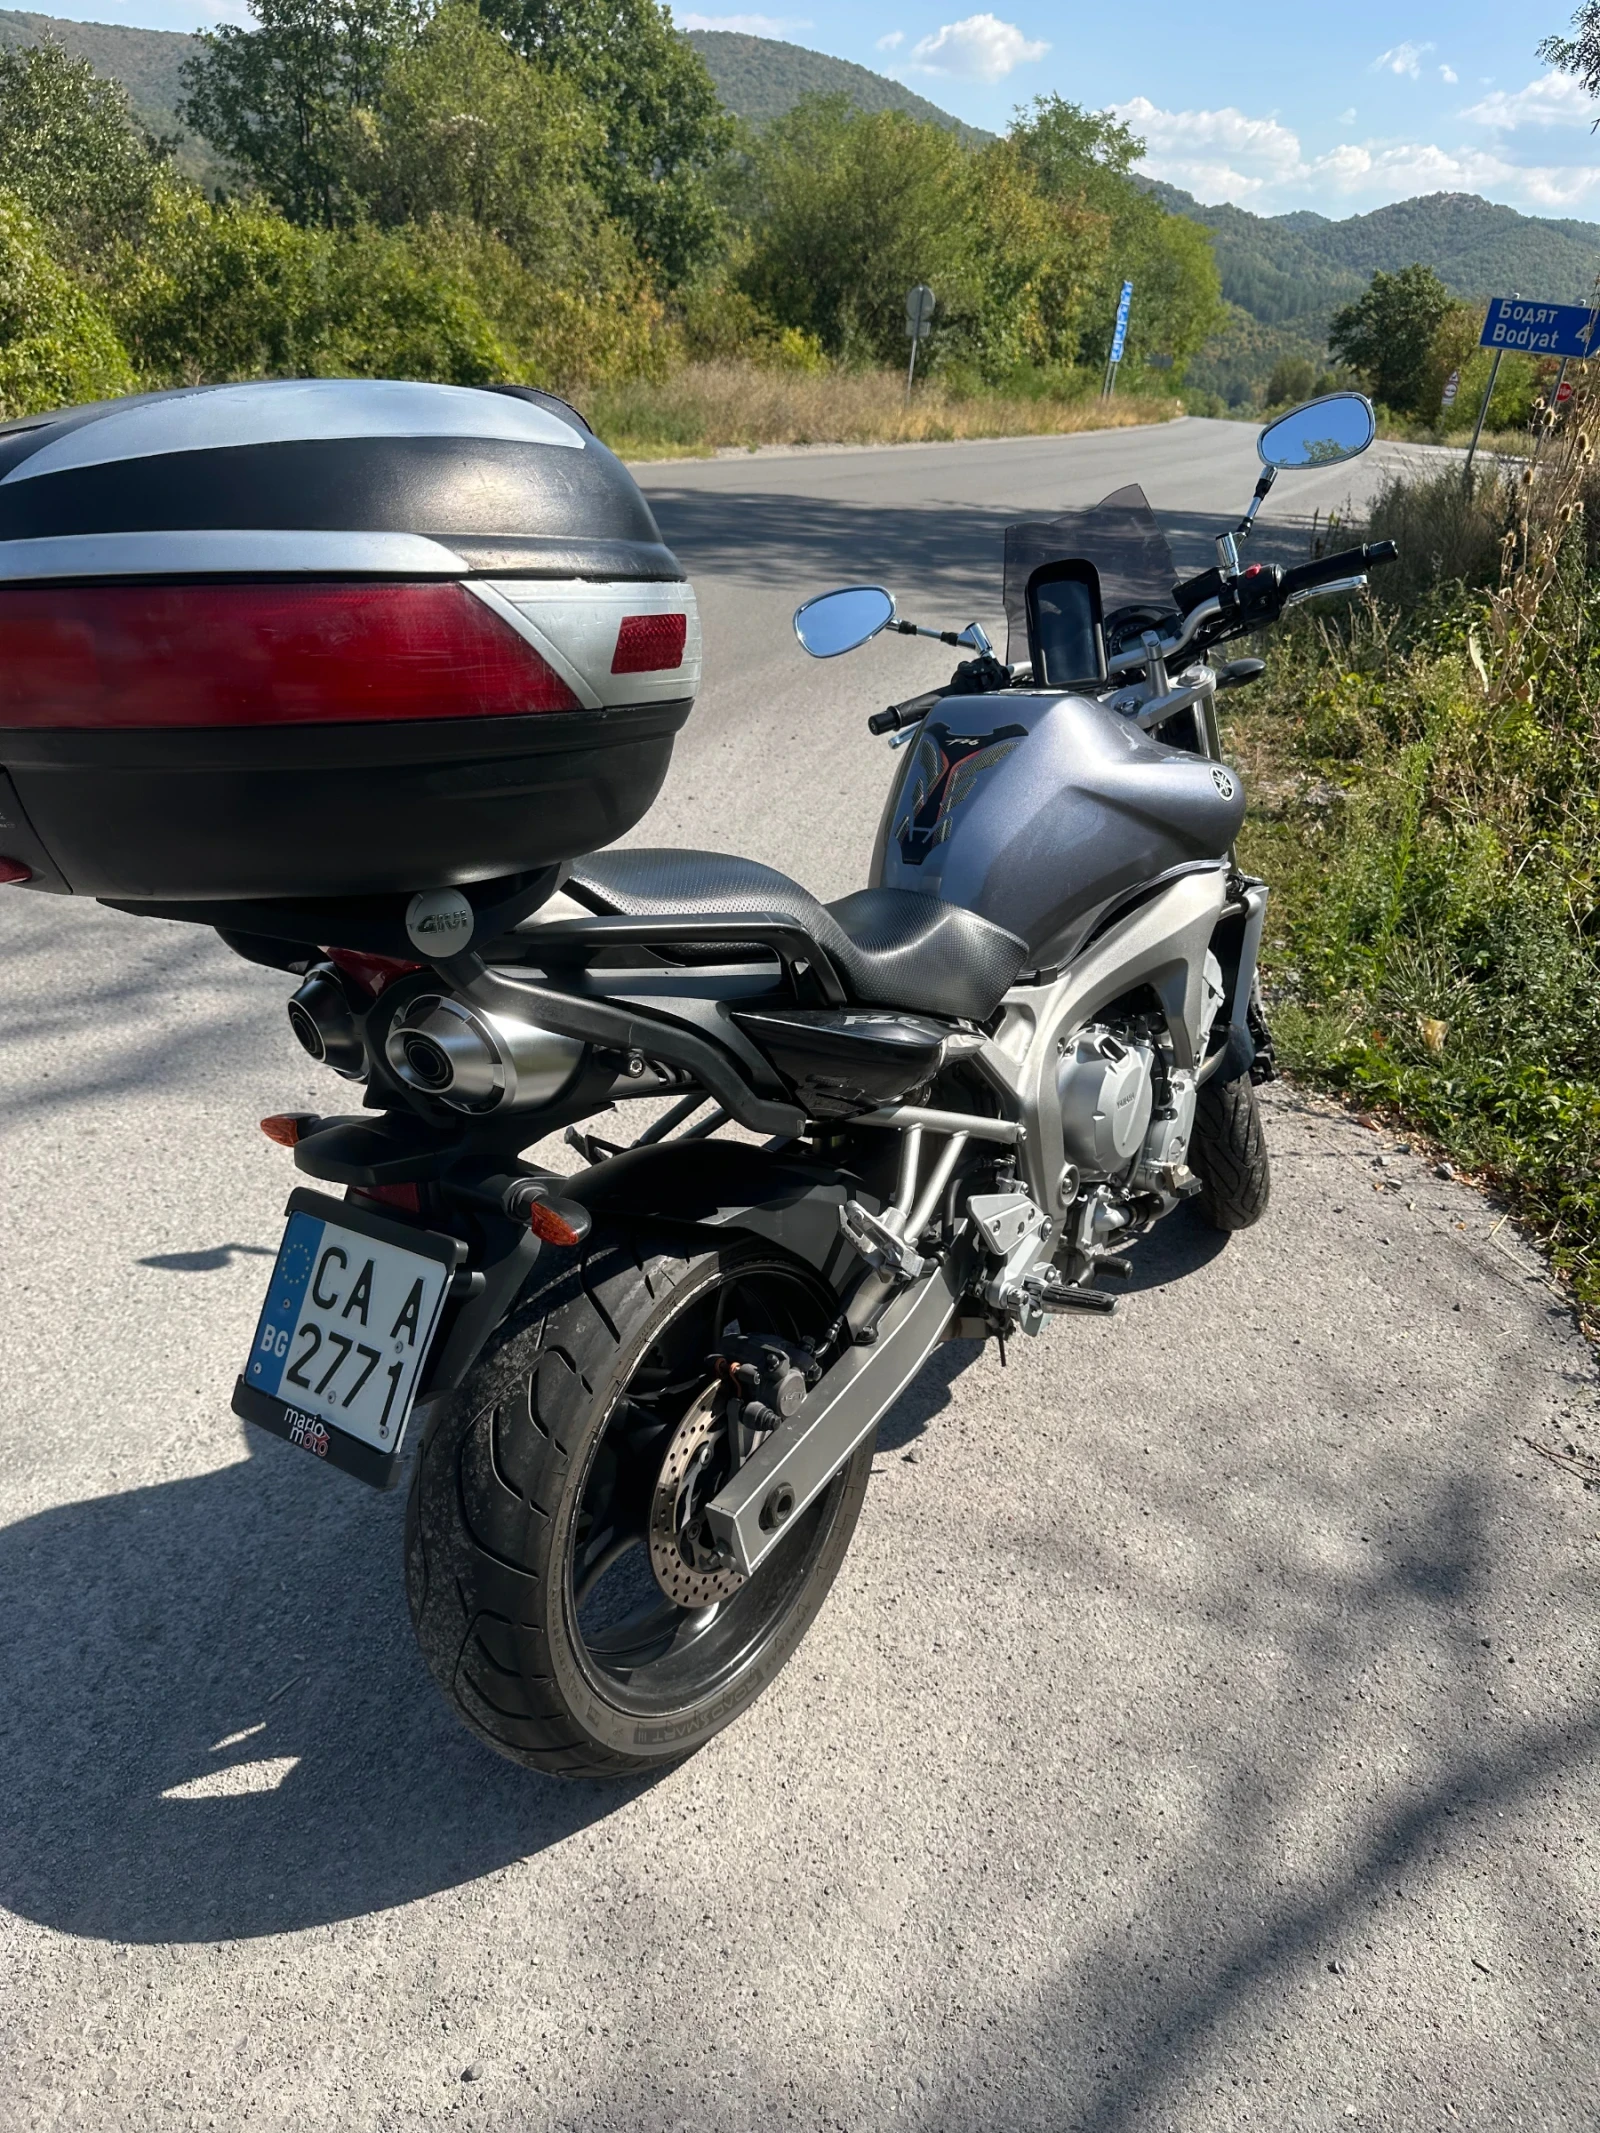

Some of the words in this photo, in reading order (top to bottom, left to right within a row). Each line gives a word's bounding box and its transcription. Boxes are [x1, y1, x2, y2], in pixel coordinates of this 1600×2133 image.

[1498, 300, 1558, 324] Бодят
[1492, 323, 1559, 350] Bodyat
[417, 909, 468, 934] GIVI
[843, 1014, 920, 1026] FZ6
[312, 1246, 375, 1327] CA
[390, 1277, 424, 1346] A
[260, 1324, 289, 1358] BG
[286, 1323, 404, 1427] 2771
[284, 1407, 325, 1438] mario
